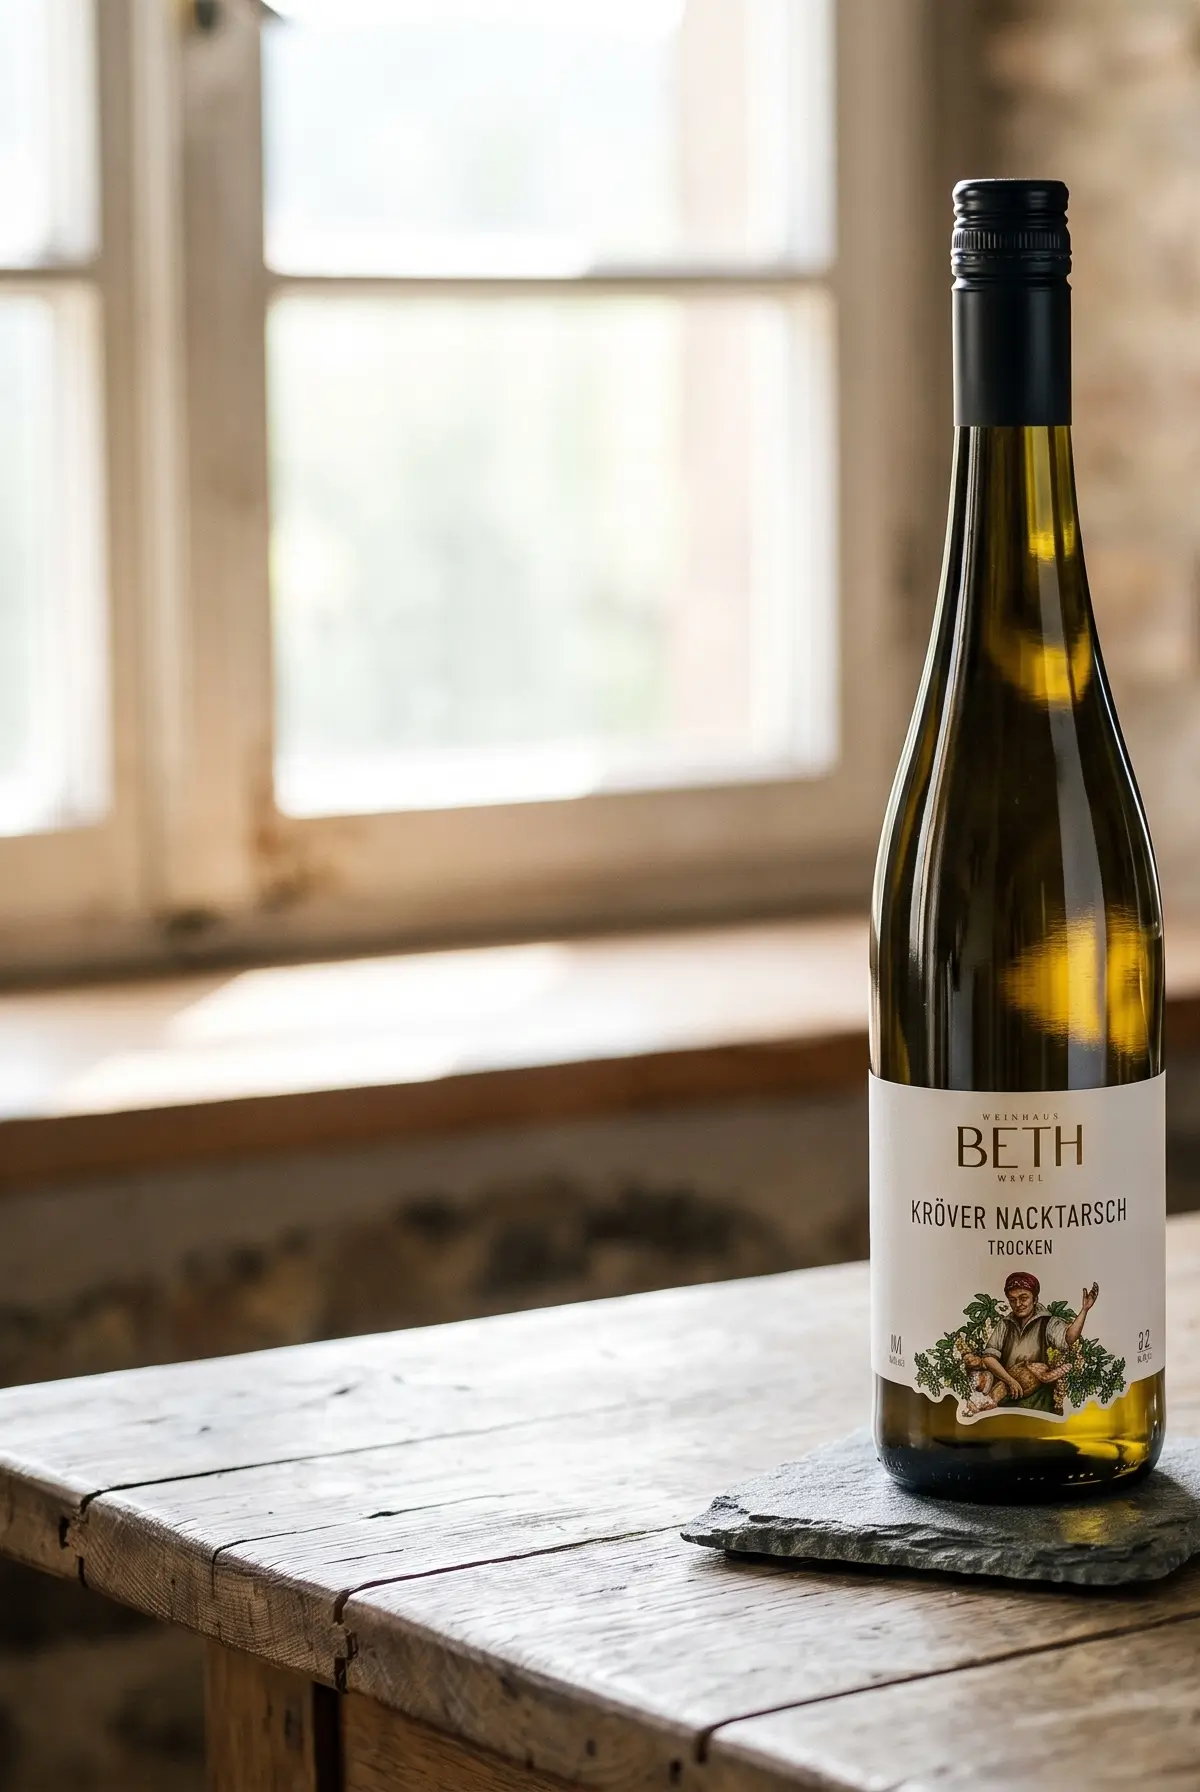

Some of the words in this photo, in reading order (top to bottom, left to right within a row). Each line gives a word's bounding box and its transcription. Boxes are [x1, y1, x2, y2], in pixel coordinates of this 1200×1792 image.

[982, 1113, 1060, 1121] WEINHAUS
[958, 1125, 1083, 1169] BETH
[911, 1198, 986, 1229] KRÖVER
[996, 1198, 1127, 1229] NACKTARSCH
[988, 1239, 1053, 1255] TROCKEN
